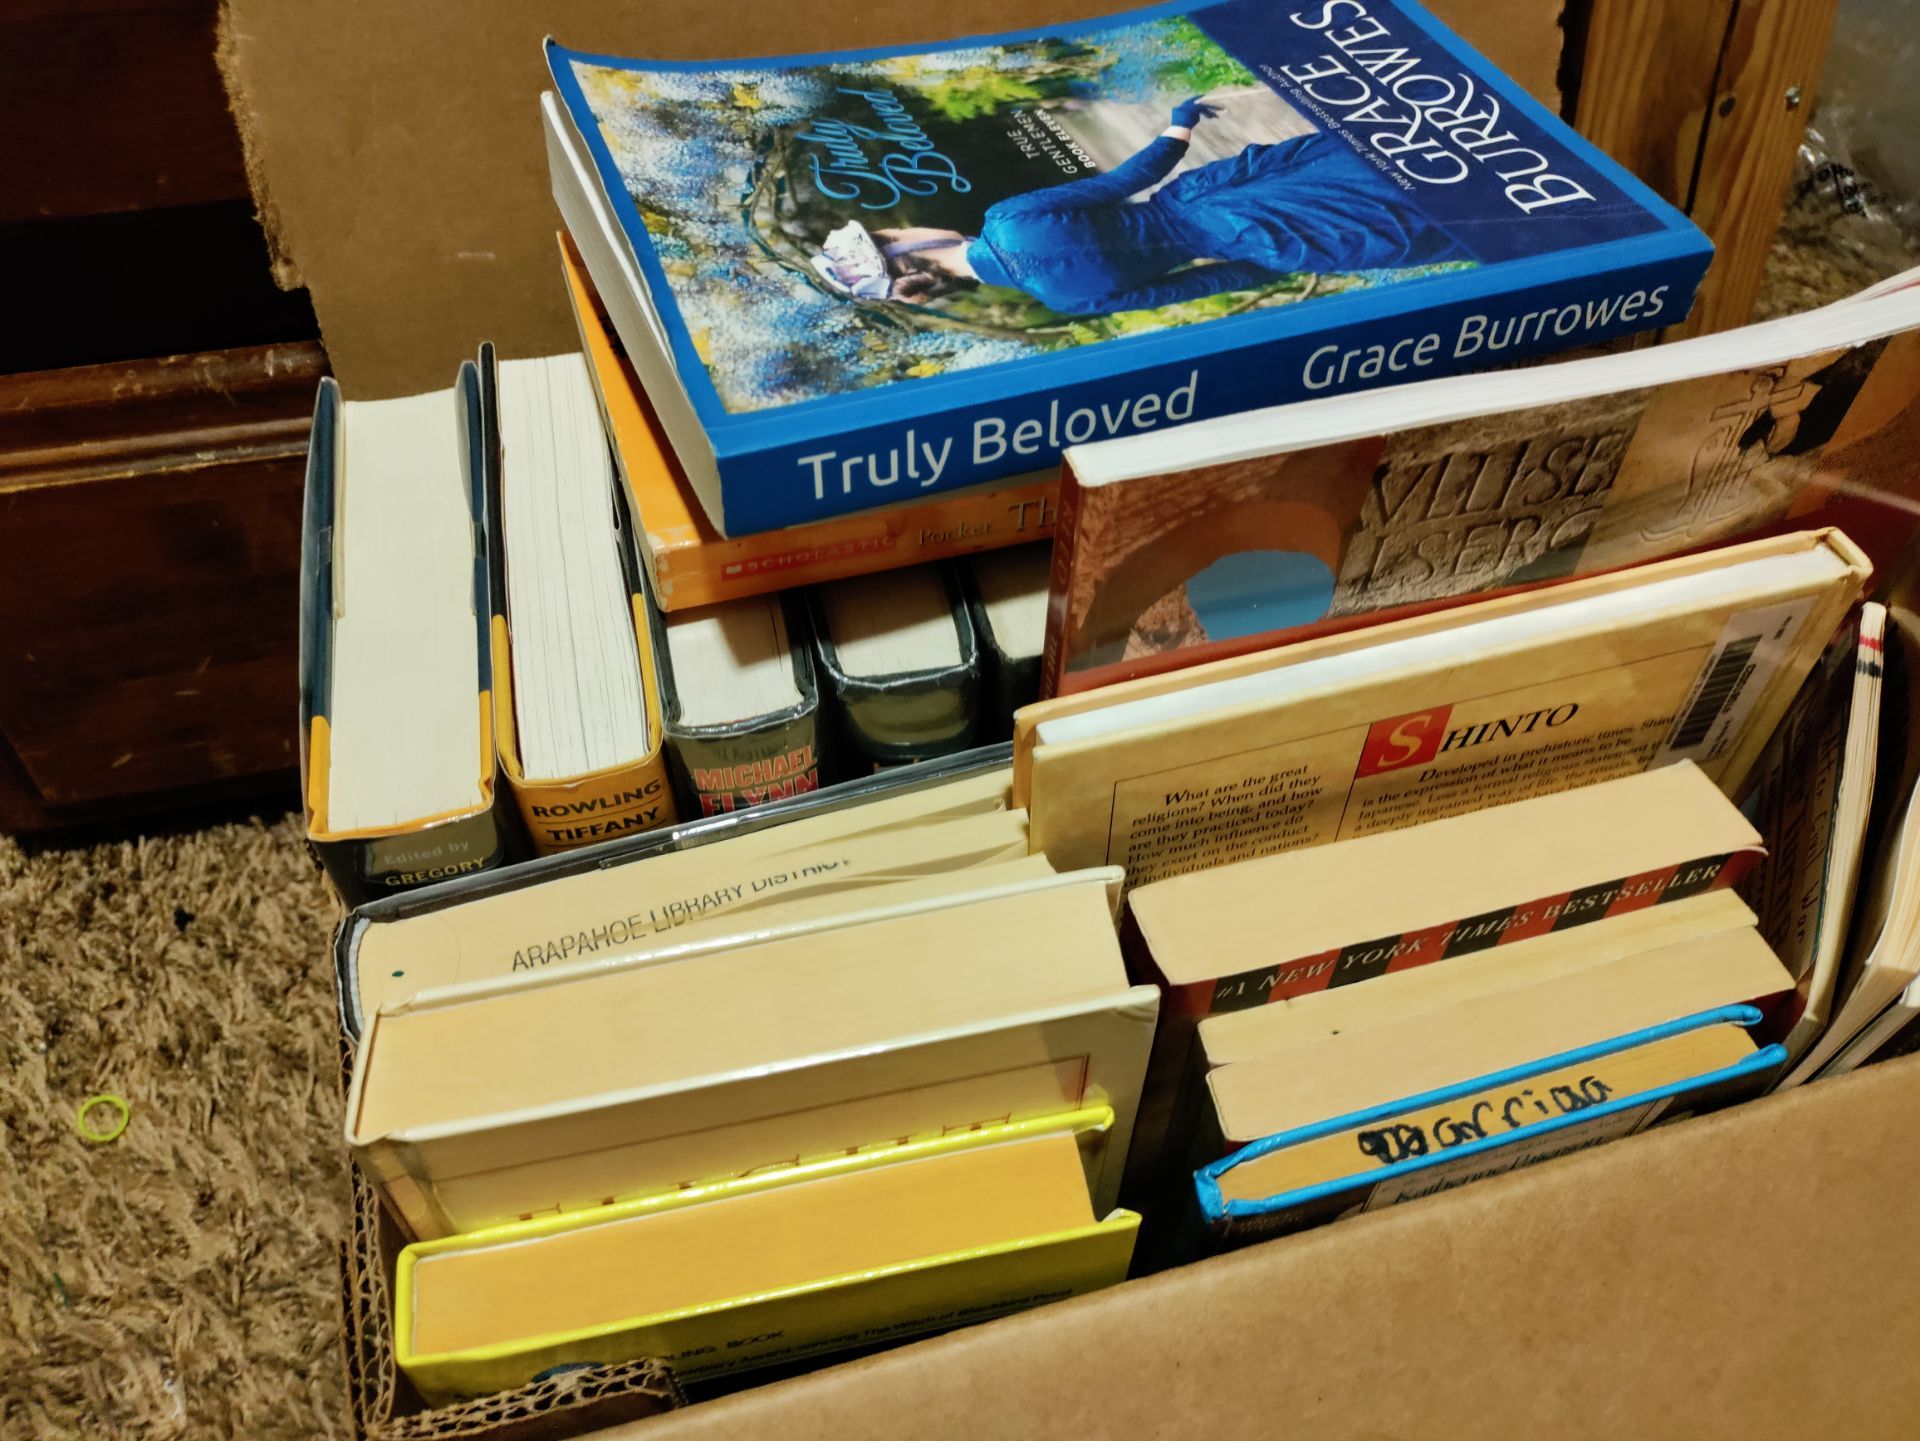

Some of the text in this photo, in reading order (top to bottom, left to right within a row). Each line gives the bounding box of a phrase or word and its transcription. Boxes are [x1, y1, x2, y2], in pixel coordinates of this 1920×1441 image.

[1279, 55, 1469, 184] GRACE
[1289, 0, 1596, 214] BURROWES
[795, 118, 900, 209] Truly
[836, 87, 971, 195] Beloved
[1006, 129, 1040, 159] TRUE
[1065, 142, 1096, 169] BOOK
[1365, 152, 1391, 171] York
[1388, 171, 1417, 192] New
[797, 284, 1670, 499] Truly Beloved Grace Burrowes
[747, 536, 896, 571] SCHOLASTIC
[1377, 703, 1579, 767] SHINTO
[1418, 755, 1499, 783] Developed
[1503, 752, 1517, 763] in
[1519, 735, 1591, 761] prehistoric
[1640, 715, 1677, 731] Shint
[694, 745, 817, 791] MICHAEL
[1164, 765, 1308, 806] What are the great
[1378, 791, 1400, 805] the
[1404, 774, 1478, 798] expression
[1481, 768, 1497, 779] of
[1500, 759, 1534, 775] what
[531, 779, 662, 817] ROWLING
[546, 806, 661, 841] TIFFANY
[1130, 825, 1170, 840] come
[1175, 815, 1205, 829] into
[1258, 795, 1285, 810] and
[1291, 787, 1324, 801] how
[1132, 775, 1321, 827] religions? When did they
[1127, 814, 1304, 865] How much influence do
[1128, 800, 1314, 852] are they practiced today?
[383, 840, 470, 865] Edited by
[385, 856, 486, 887] GREGORY
[1125, 825, 1308, 879] they exert on the conduct
[1143, 857, 1225, 883] individuals
[1228, 849, 1255, 864] and
[512, 914, 647, 972] ARAPAHOE
[649, 883, 744, 933] LIBRARY
[1216, 981, 1246, 1000] #1
[1258, 960, 1334, 991] NEW
[1342, 937, 1425, 970] YORK
[1440, 911, 1531, 946] TIMES
[1542, 863, 1722, 920] BESTSELLER
